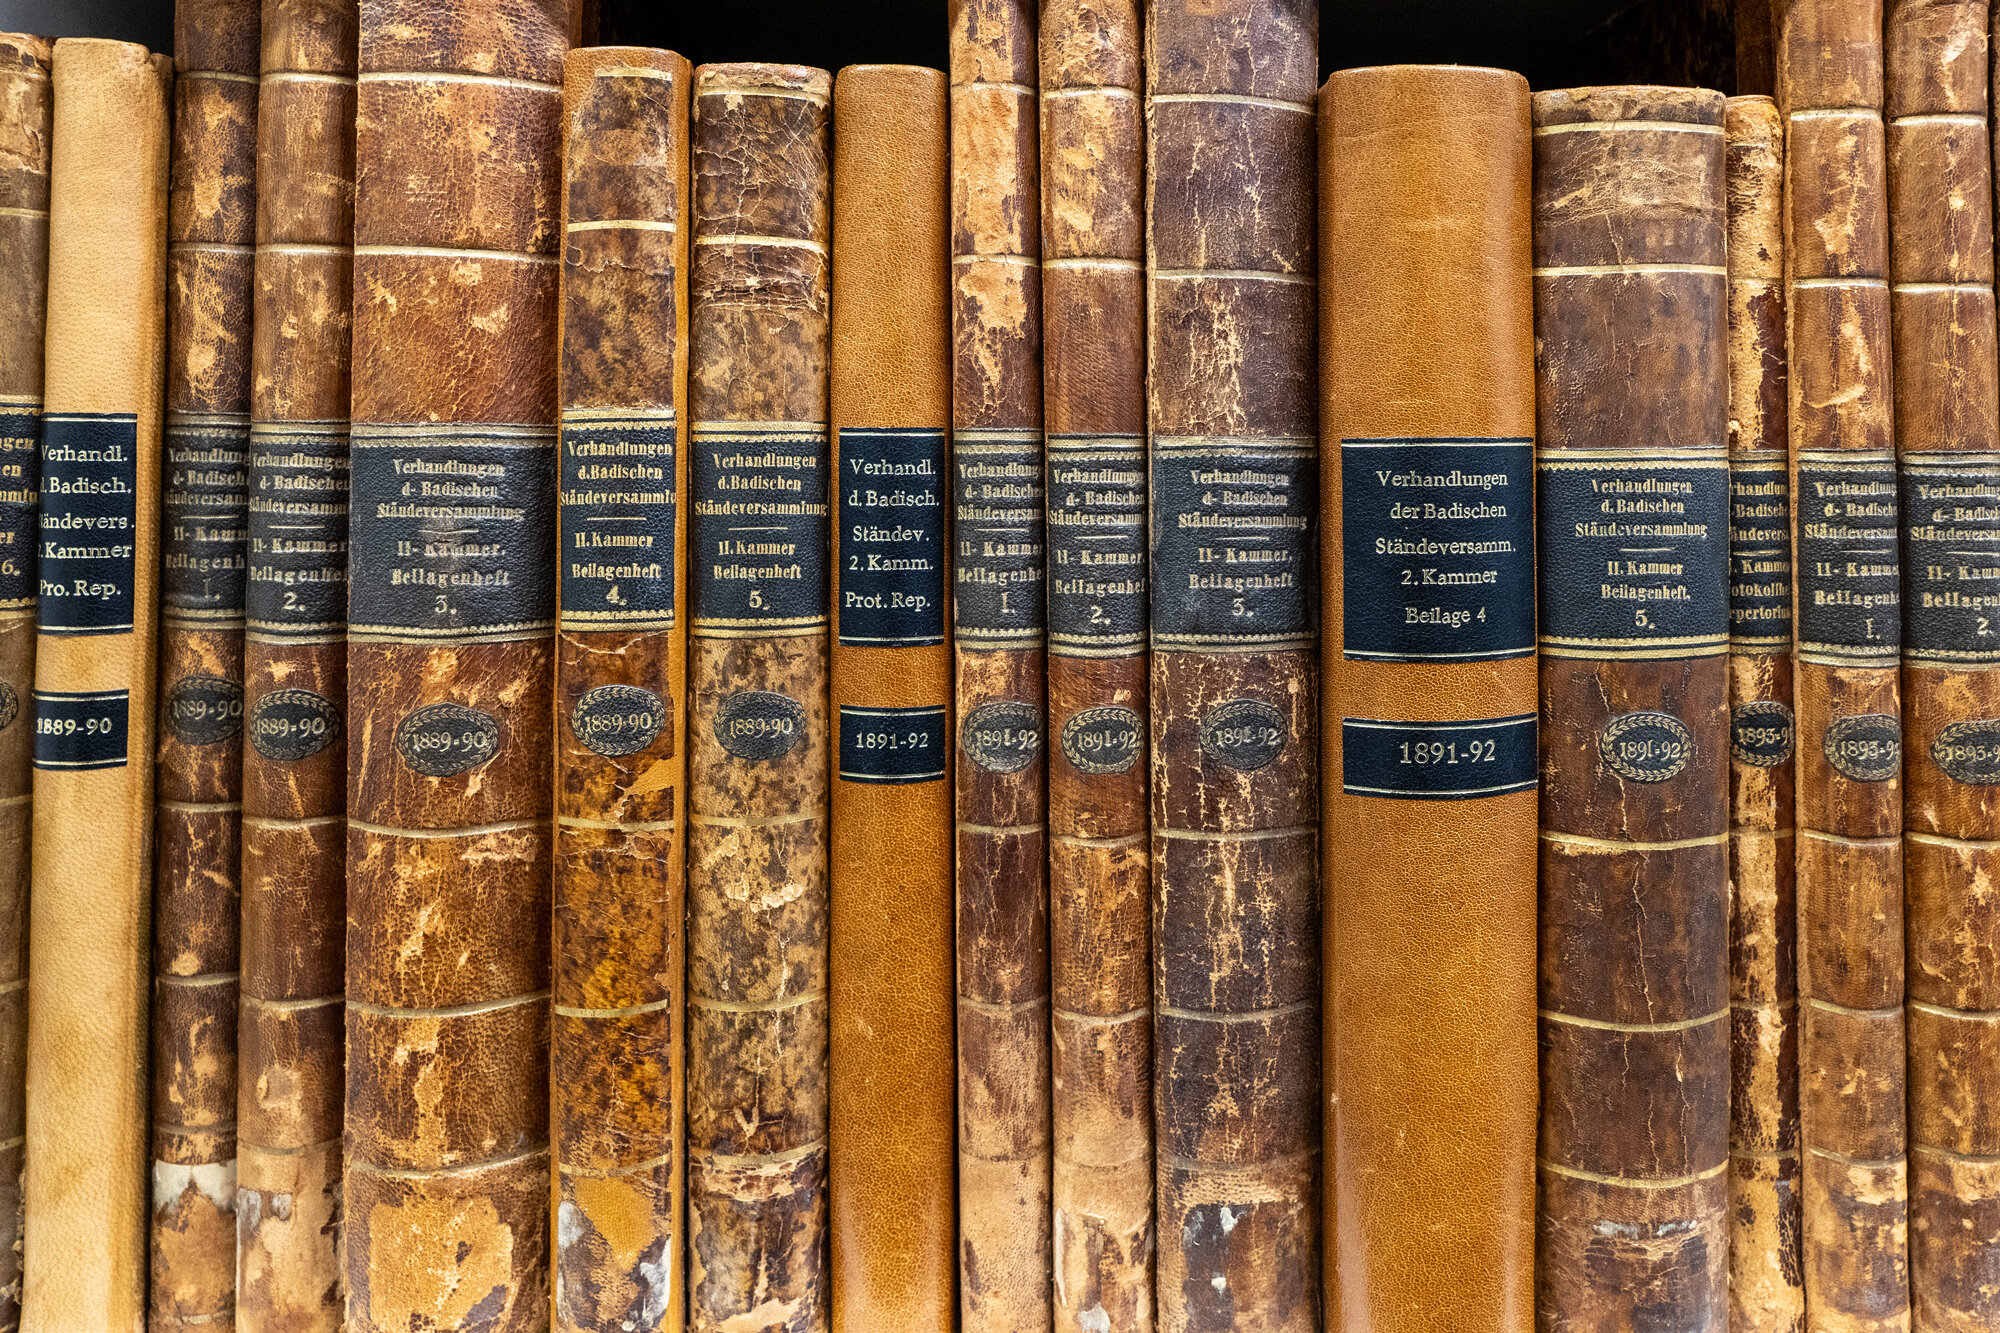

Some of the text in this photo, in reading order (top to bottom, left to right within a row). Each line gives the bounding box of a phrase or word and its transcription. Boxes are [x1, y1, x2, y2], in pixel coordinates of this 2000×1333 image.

[567, 440, 673, 459] Verhandlungen
[393, 458, 505, 479] Verhandlungen
[712, 452, 817, 470] Verhandlungen
[849, 458, 936, 476] Verhandl.
[50, 477, 132, 494] Badisch.
[1190, 468, 1290, 488] Verhandlungen
[1376, 470, 1508, 490] Verhandlungen
[421, 481, 499, 498] Badischen
[865, 489, 940, 507] Badisch.
[1222, 490, 1288, 506] Badischen
[1390, 502, 1508, 519] der Badischen
[1616, 498, 1685, 513] Badischen
[1178, 511, 1308, 530] Ständeversammlung
[1575, 521, 1708, 538] Ständeversammlung
[852, 525, 930, 542] Ständev.
[45, 542, 132, 559] Kammer
[1375, 537, 1516, 555] Ständeversamm.
[571, 562, 661, 581] Beilagenheft
[713, 563, 802, 582] Beilagenheft
[849, 554, 934, 572] 2. Kamm.
[1627, 560, 1684, 576] Kammer
[391, 568, 510, 588] Beilagenheft
[1188, 572, 1293, 592] Beilagenheft
[1401, 568, 1498, 586] 2. Kammer
[40, 579, 121, 600] Pro. Rep.
[283, 591, 305, 612] 2.
[434, 594, 457, 615] 3.
[845, 591, 931, 612] Prot. Rep.
[1231, 597, 1255, 617] 3.
[1090, 604, 1111, 625] 2.
[1405, 606, 1487, 628] Beilage 4
[1635, 608, 1656, 629] 5.
[36, 717, 112, 736] 1889-90
[256, 717, 326, 738] 1889-90
[584, 713, 653, 735] 1889-90
[729, 717, 793, 738] 1889-90
[412, 732, 487, 752] 1889-90
[856, 732, 929, 751] 1891-92
[1077, 730, 1141, 752] 1891-92
[1215, 728, 1280, 750] 1891-92
[1399, 739, 1496, 766] 1891-92
[1620, 739, 1681, 760] 1891-92
